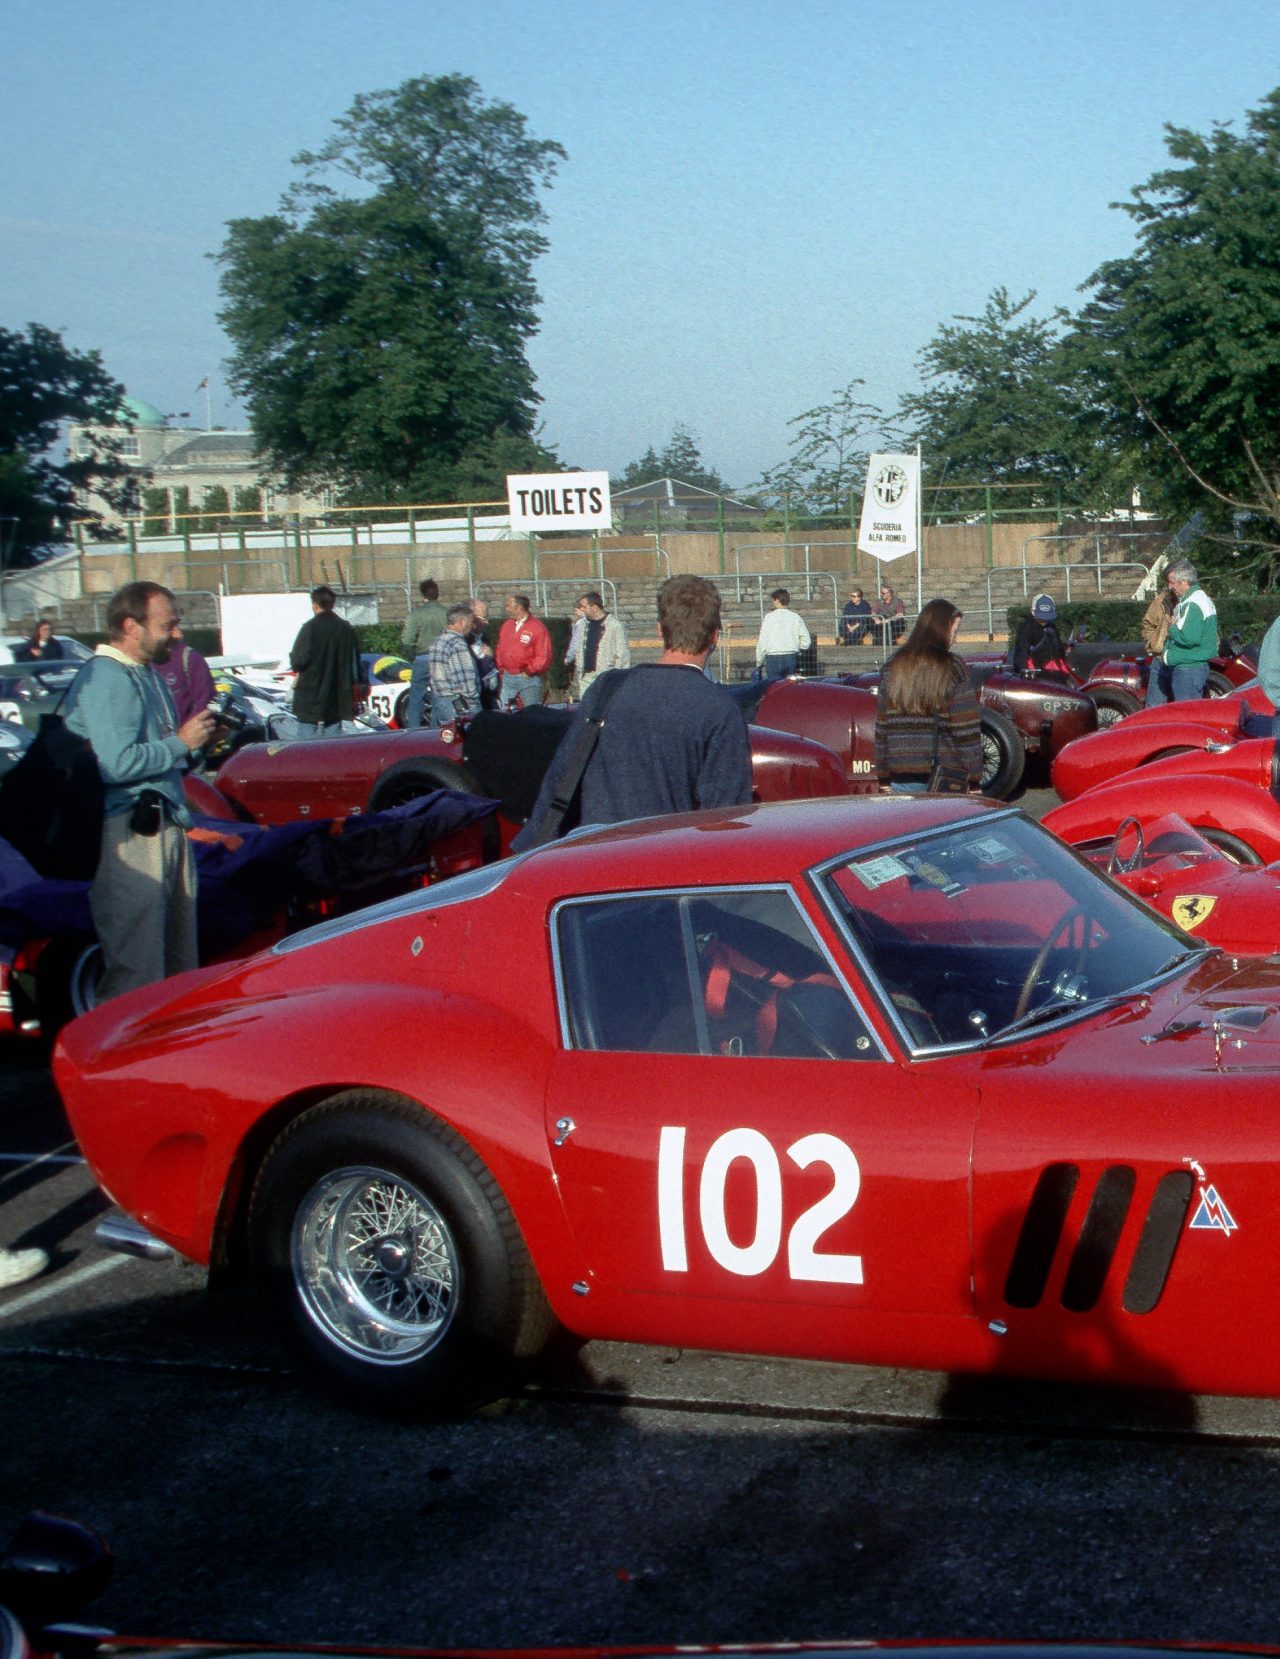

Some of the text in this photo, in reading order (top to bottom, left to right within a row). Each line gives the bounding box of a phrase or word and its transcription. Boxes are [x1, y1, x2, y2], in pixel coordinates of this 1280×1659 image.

[517, 487, 602, 516] TOILETS
[869, 533, 907, 543] ALFA ROMEO
[873, 522, 902, 532] SCUDERIA
[371, 696, 391, 718] 53
[658, 1126, 864, 1285] 102
